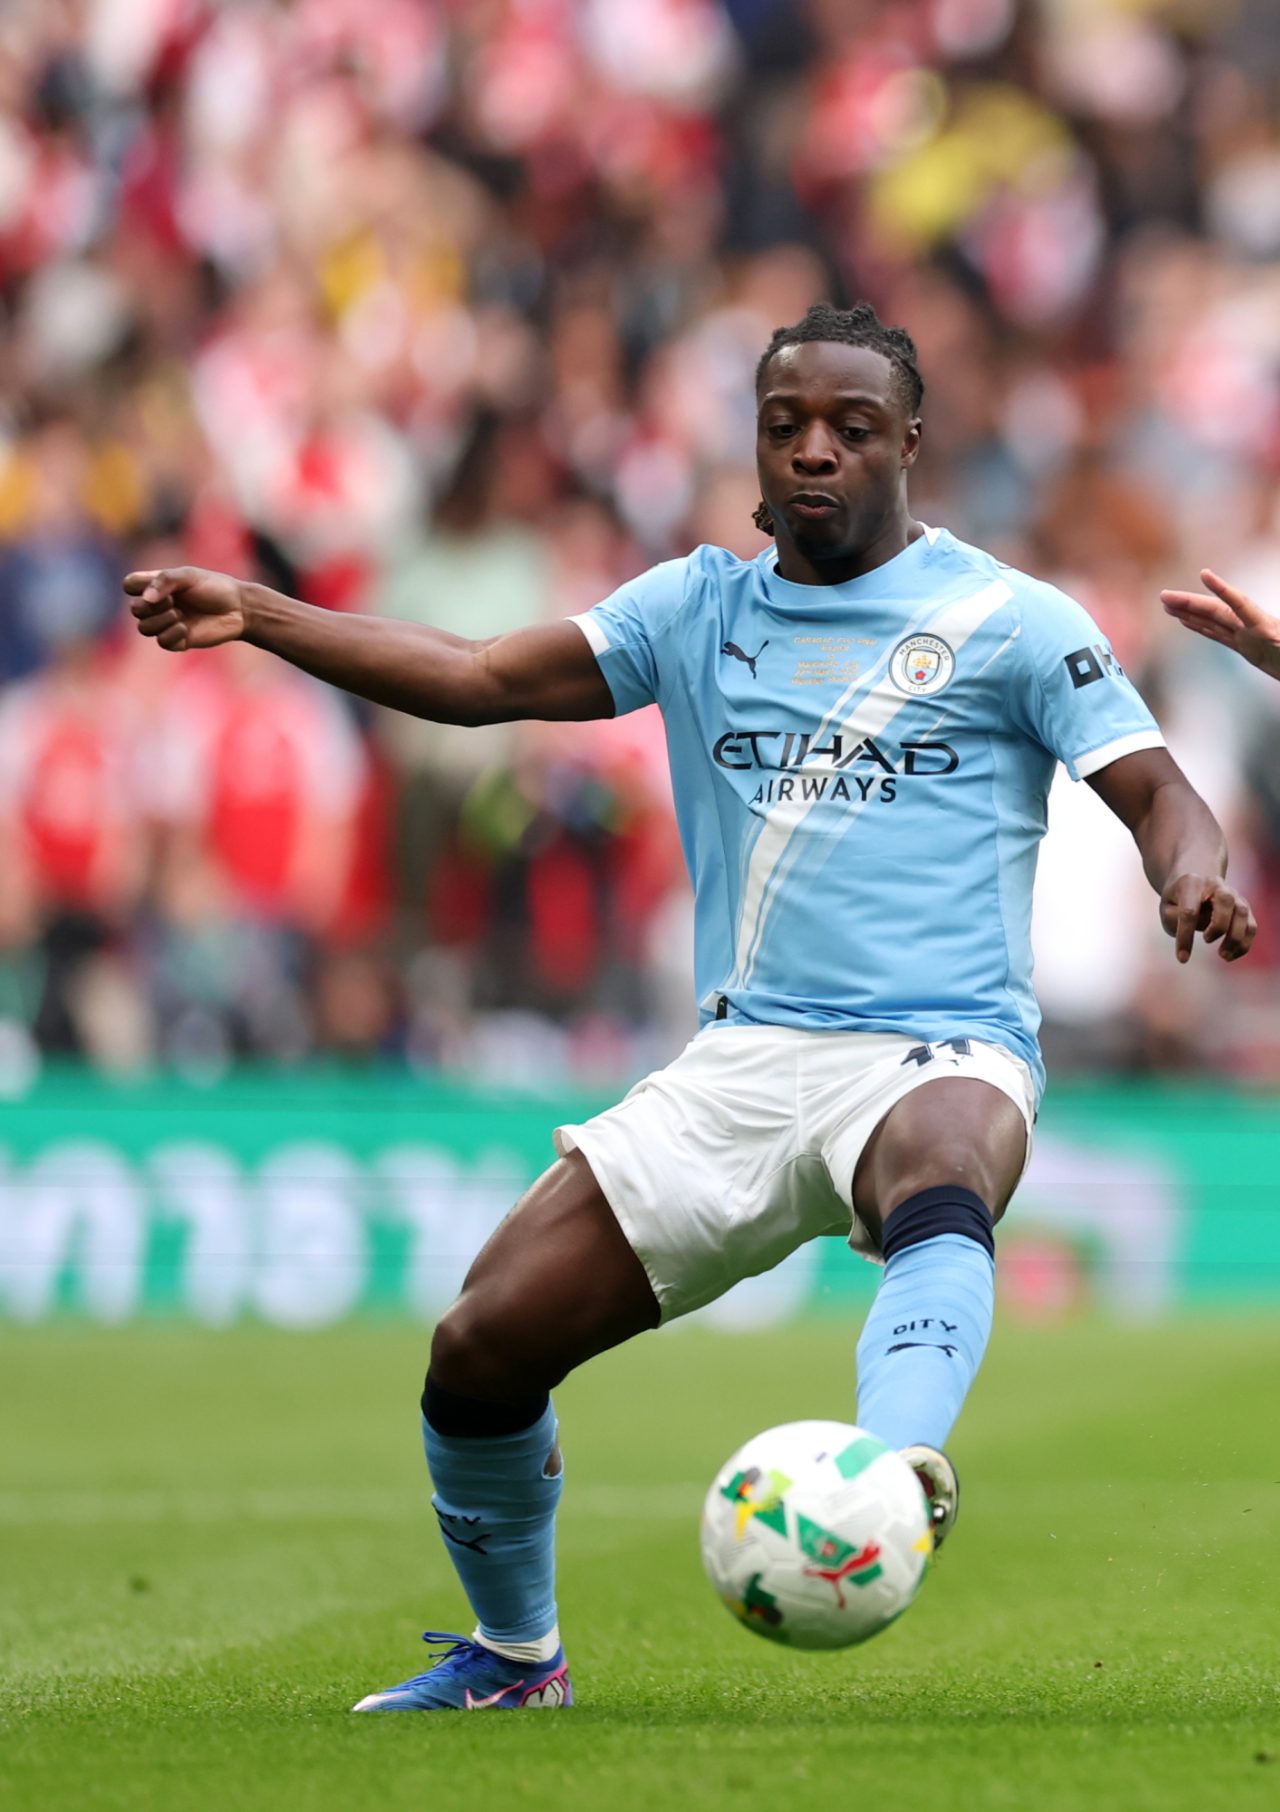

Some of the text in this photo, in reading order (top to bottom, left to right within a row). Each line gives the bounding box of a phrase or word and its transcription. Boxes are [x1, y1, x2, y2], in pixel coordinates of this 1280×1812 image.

[899, 638, 950, 661] MANCHESTER
[908, 685, 927, 693] CITY
[712, 731, 960, 776] ETIHAD
[748, 777, 897, 804] AIRWAYS
